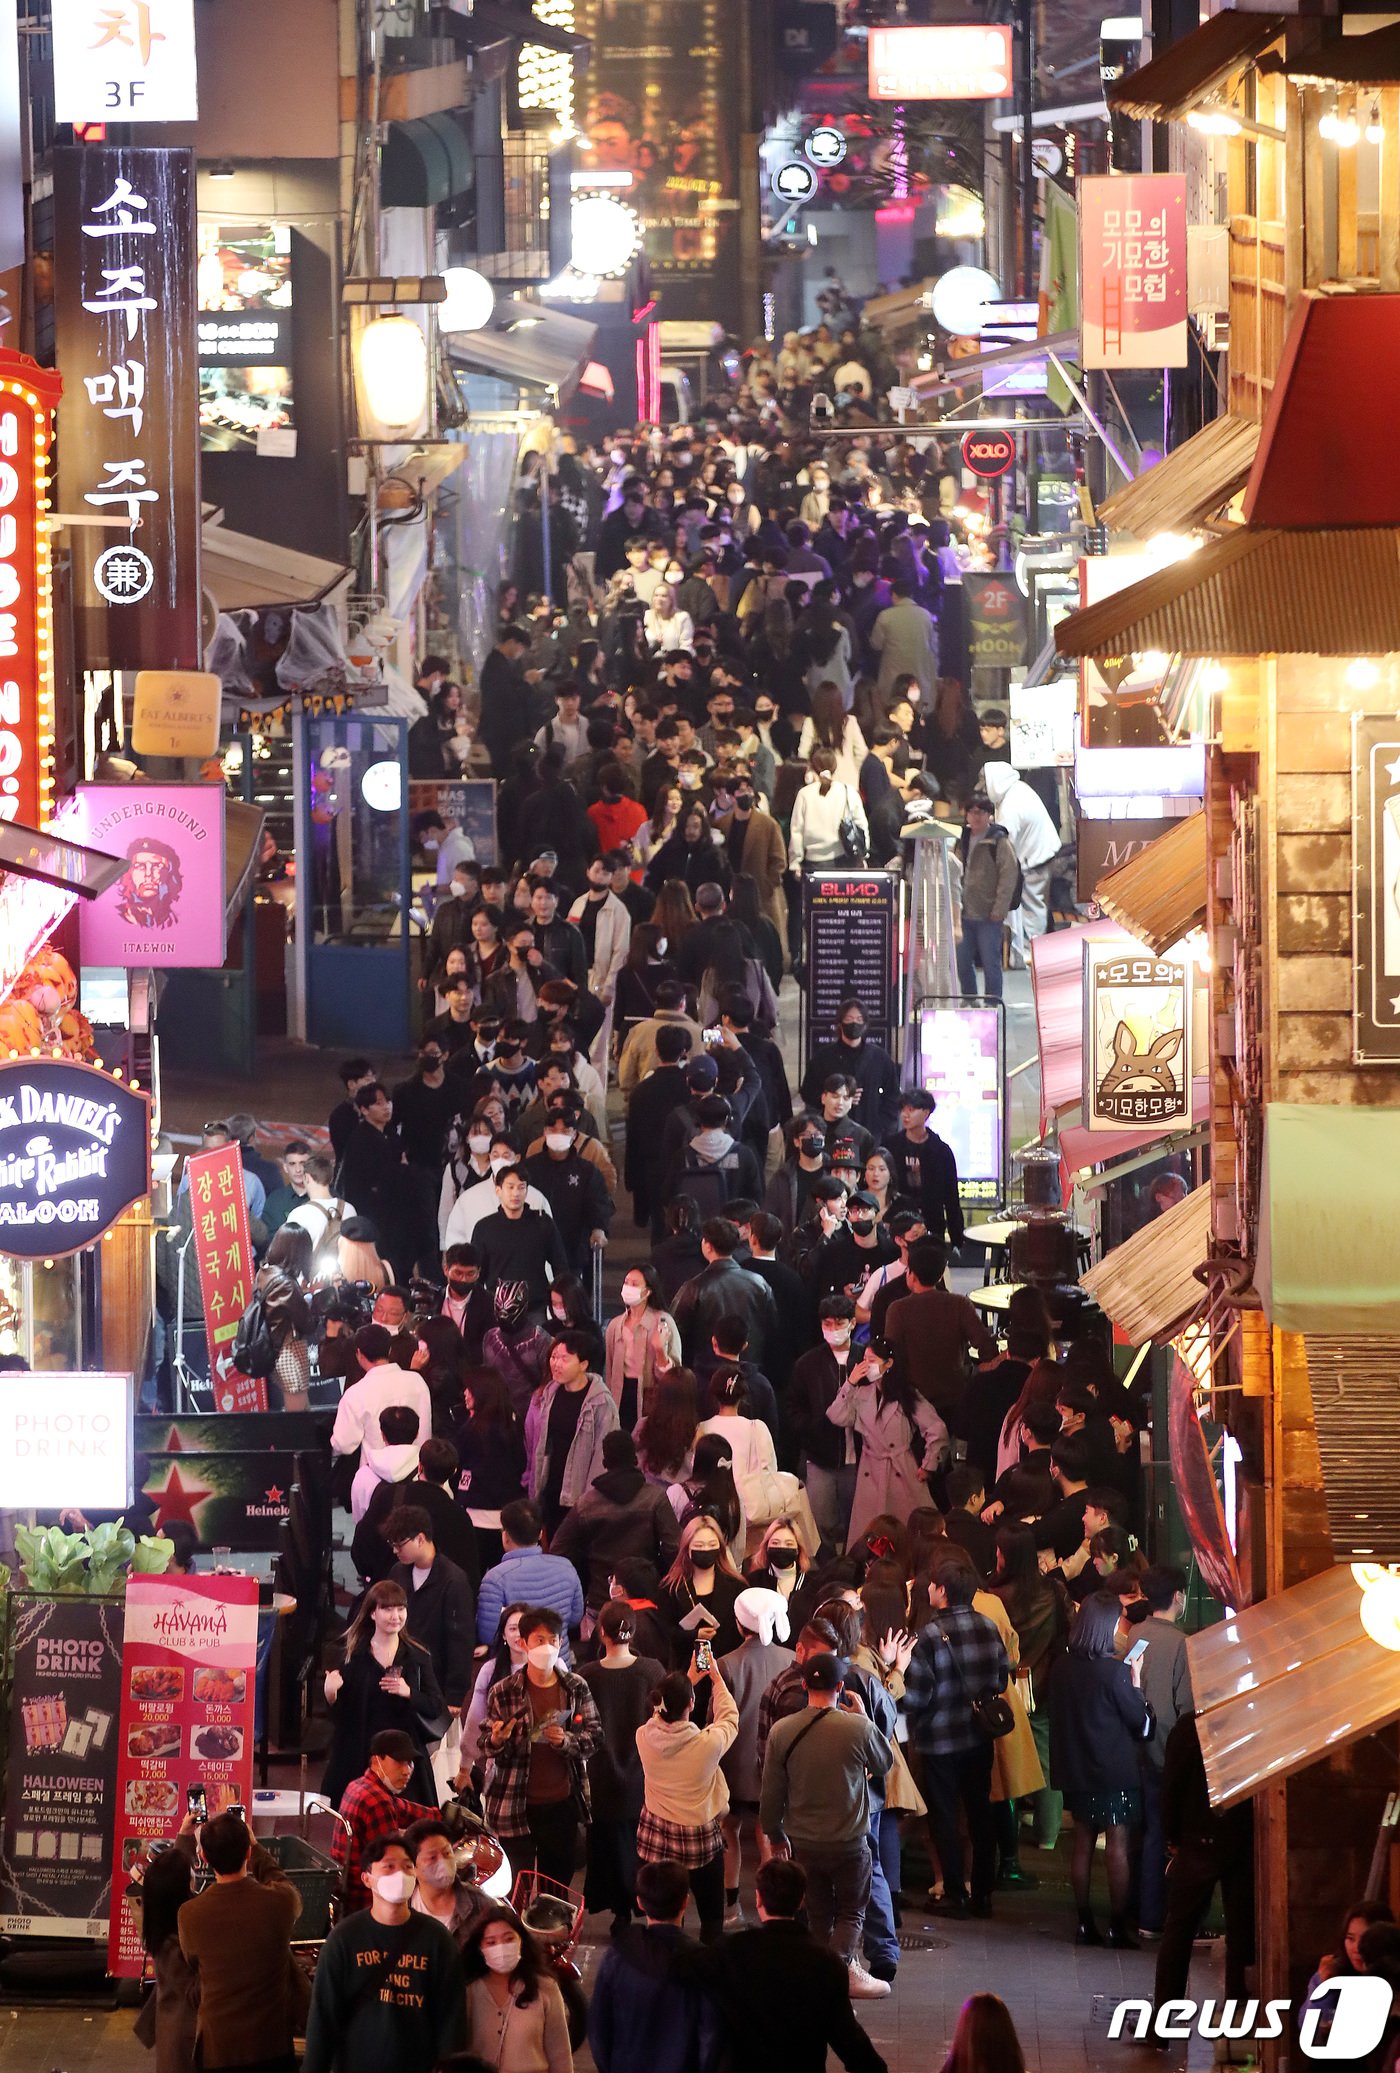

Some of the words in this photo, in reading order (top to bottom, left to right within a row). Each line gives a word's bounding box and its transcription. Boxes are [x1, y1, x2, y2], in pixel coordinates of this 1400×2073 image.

[105, 81, 145, 107] 3F
[1102, 207, 1167, 238] 모모의
[1102, 239, 1170, 270] 기묘한
[81, 178, 160, 533] 소주맥주
[969, 443, 1009, 459] XOLO
[984, 591, 1008, 609] 2F
[91, 802, 207, 841] UNDERGROUND
[123, 943, 176, 953] ITAEWON
[1108, 961, 1175, 985] 모모의
[20, 1084, 122, 1146] DANIEL'S
[1105, 1097, 1177, 1119] 기묘한모험
[35, 1142, 110, 1196] Rabbit
[196, 1170, 226, 1320] 장칼국수
[217, 1164, 247, 1311] 판매개시
[15, 1414, 111, 1433] PHOTO
[15, 1439, 107, 1457] DRINK
[153, 1608, 228, 1636] HAVANA
[36, 1638, 105, 1656] PHOTO
[158, 1637, 186, 1647] CLUB
[189, 1637, 196, 1647] &
[199, 1638, 221, 1648] PUB
[36, 1654, 102, 1672] DRINK
[142, 1713, 170, 1722] 20,000
[204, 1703, 232, 1715] 돈까스
[205, 1714, 232, 1724] 13,000
[140, 1770, 167, 1779] 17,000
[198, 1761, 234, 1773] 스테이크
[23, 1775, 105, 1792] HALLOWEEN
[21, 1789, 51, 1802] 스페셜
[52, 1790, 82, 1803] 프레임
[84, 1792, 104, 1805] 출시
[136, 1828, 164, 1837] 35,000
[7, 1917, 32, 1925] PHOTO
[356, 1950, 382, 1968] FOR
[396, 1992, 425, 2009] CITY
